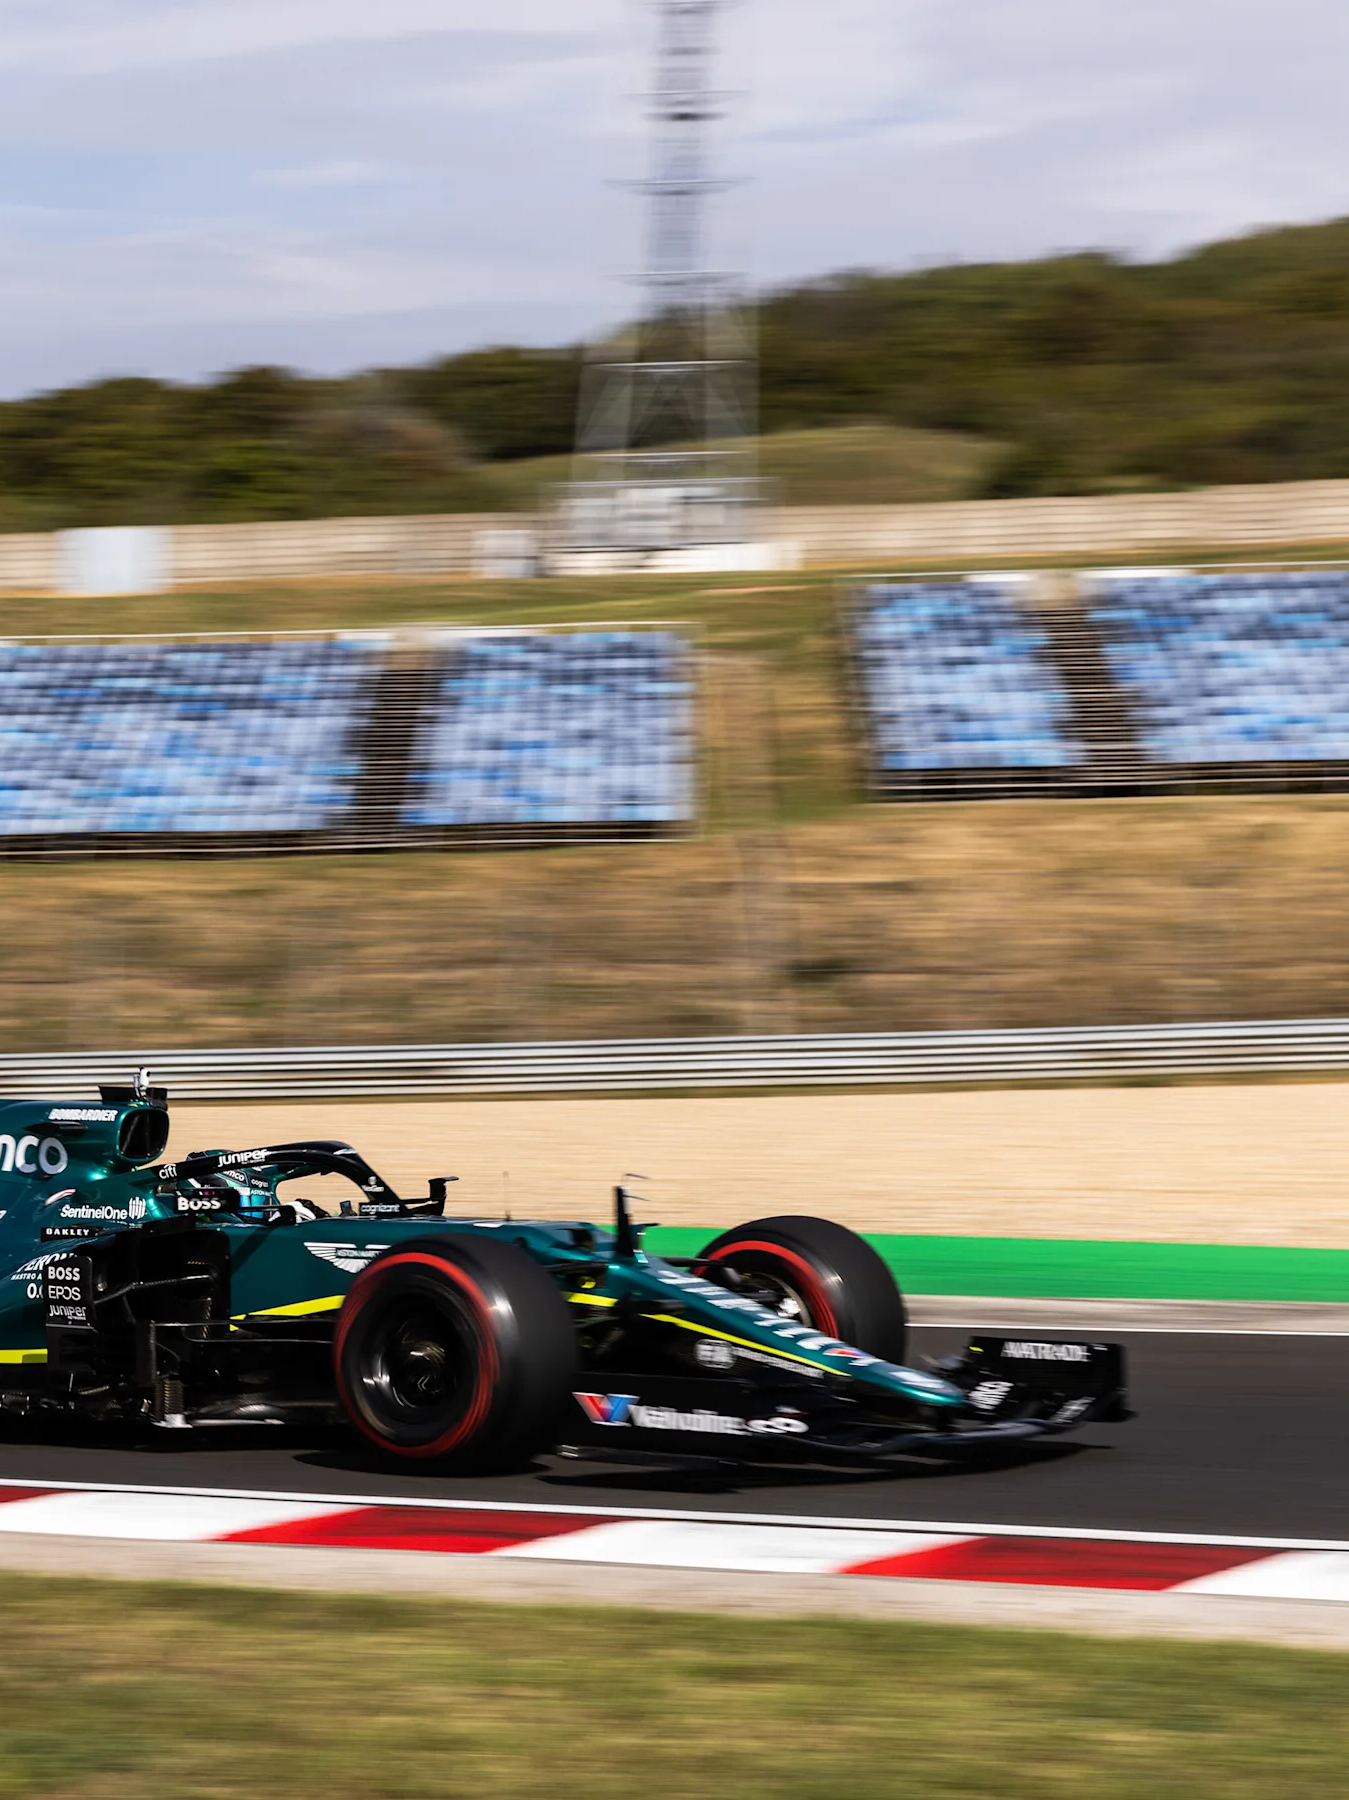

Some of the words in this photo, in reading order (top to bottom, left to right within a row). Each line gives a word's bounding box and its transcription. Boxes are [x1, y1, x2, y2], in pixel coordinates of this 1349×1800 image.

[48, 1108, 119, 1122] BOMBARDIER
[158, 1163, 178, 1179] citi
[61, 1203, 128, 1219] SentinelOne
[177, 1197, 221, 1211] BOSS
[360, 1203, 401, 1215] cognizant
[45, 1228, 90, 1236] OAKLEY
[48, 1266, 81, 1282] BOSS
